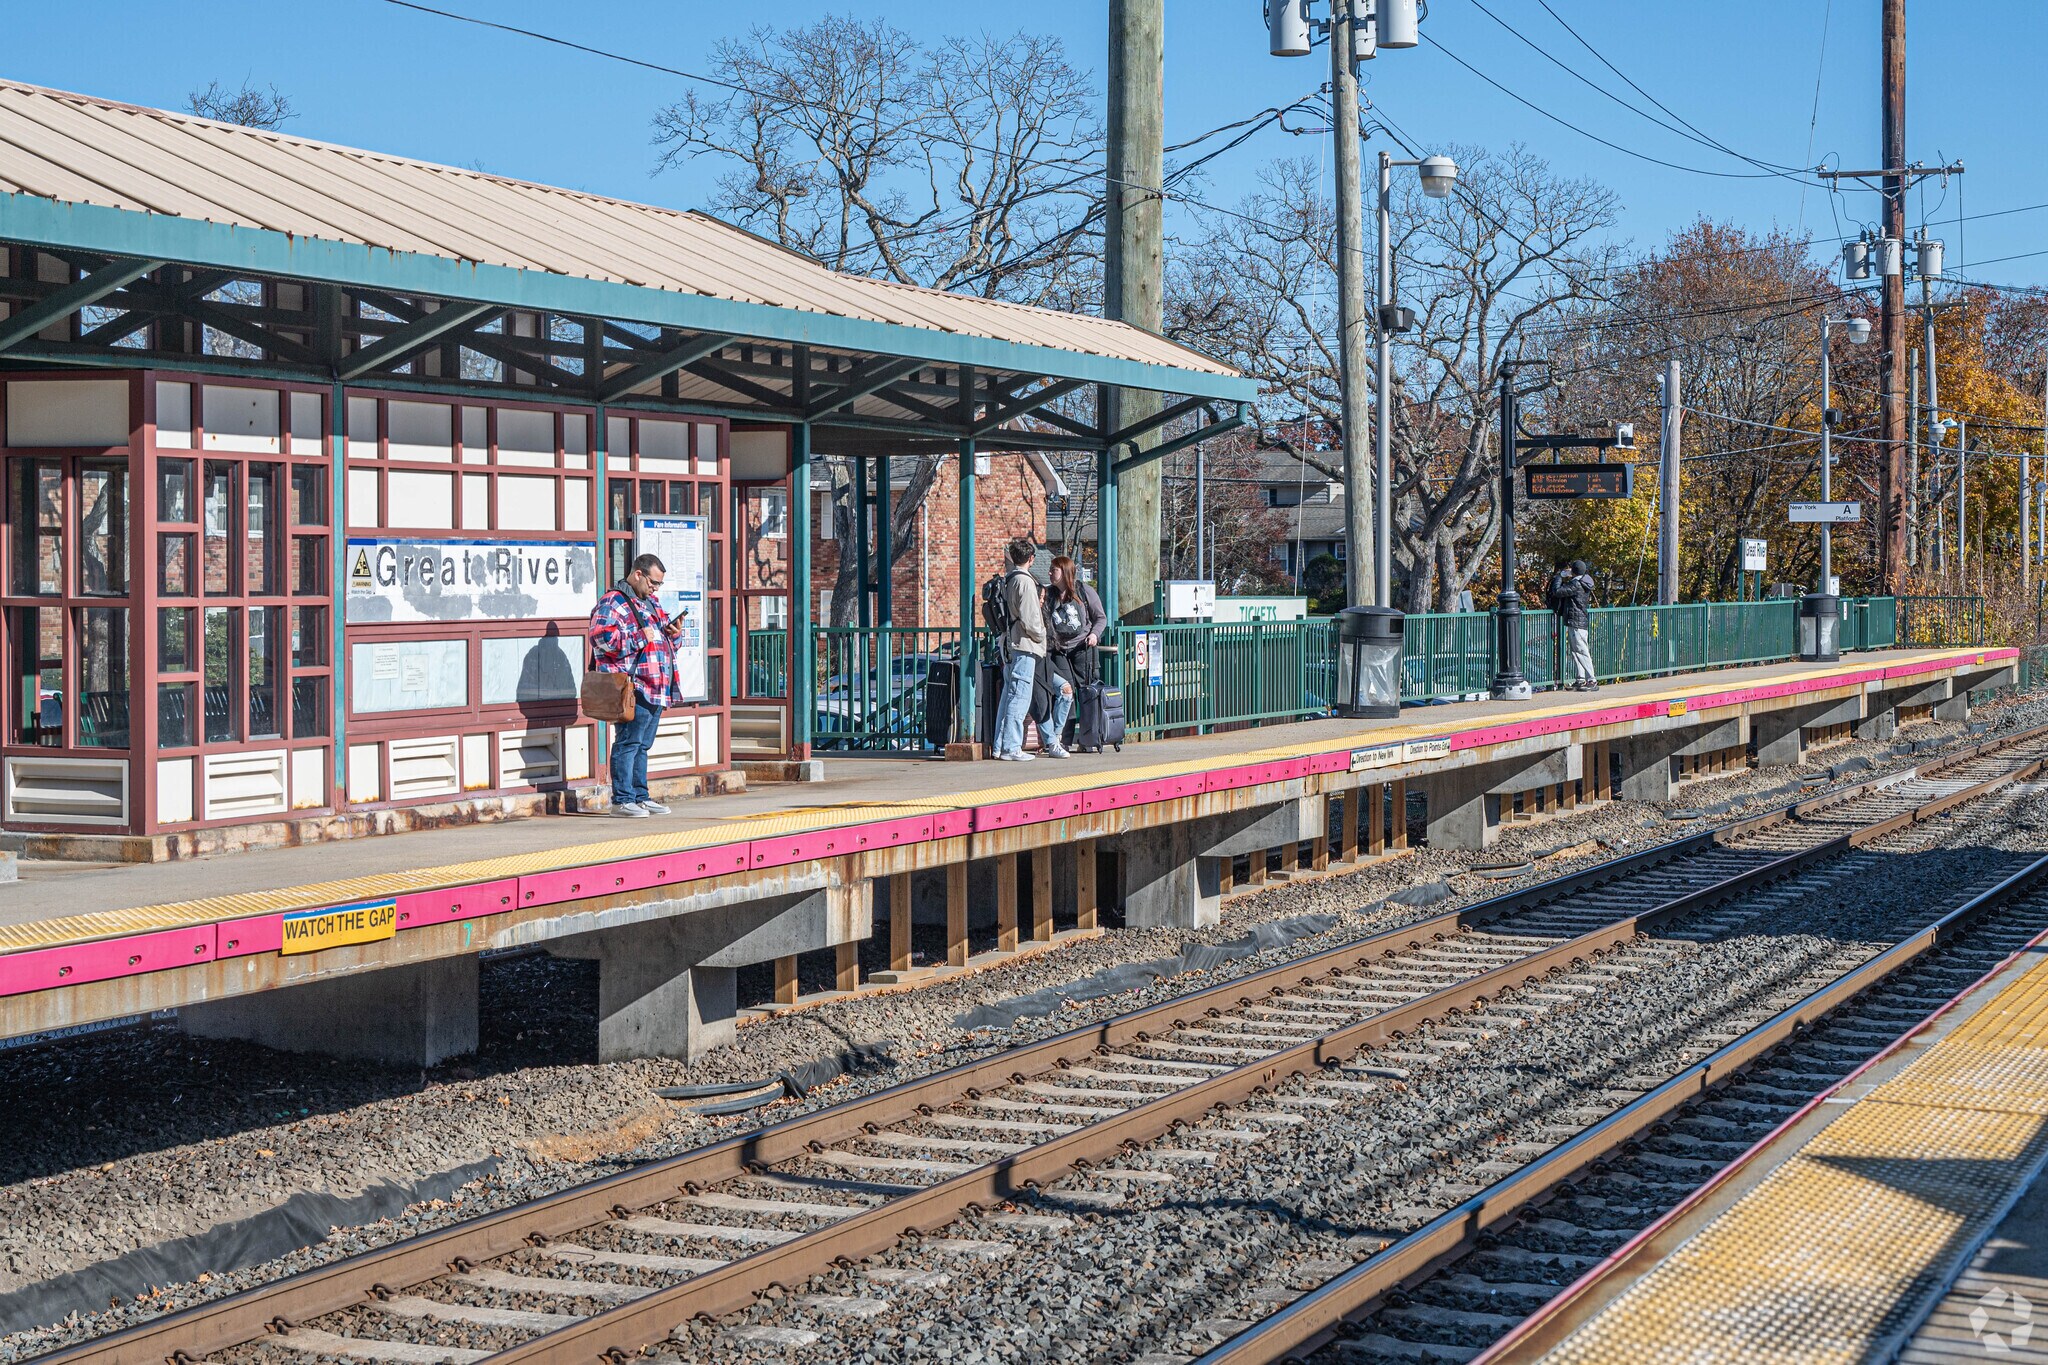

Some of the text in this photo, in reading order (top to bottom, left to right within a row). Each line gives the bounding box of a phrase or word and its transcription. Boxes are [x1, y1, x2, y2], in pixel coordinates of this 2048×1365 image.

[1843, 505, 1851, 514] A
[1745, 541, 1756, 557] Great
[376, 546, 573, 587] Great River
[1239, 606, 1276, 622] TICKETS
[1356, 753, 1371, 764] Direction
[1378, 751, 1386, 760] New
[285, 907, 395, 940] WATCH THE GAP
